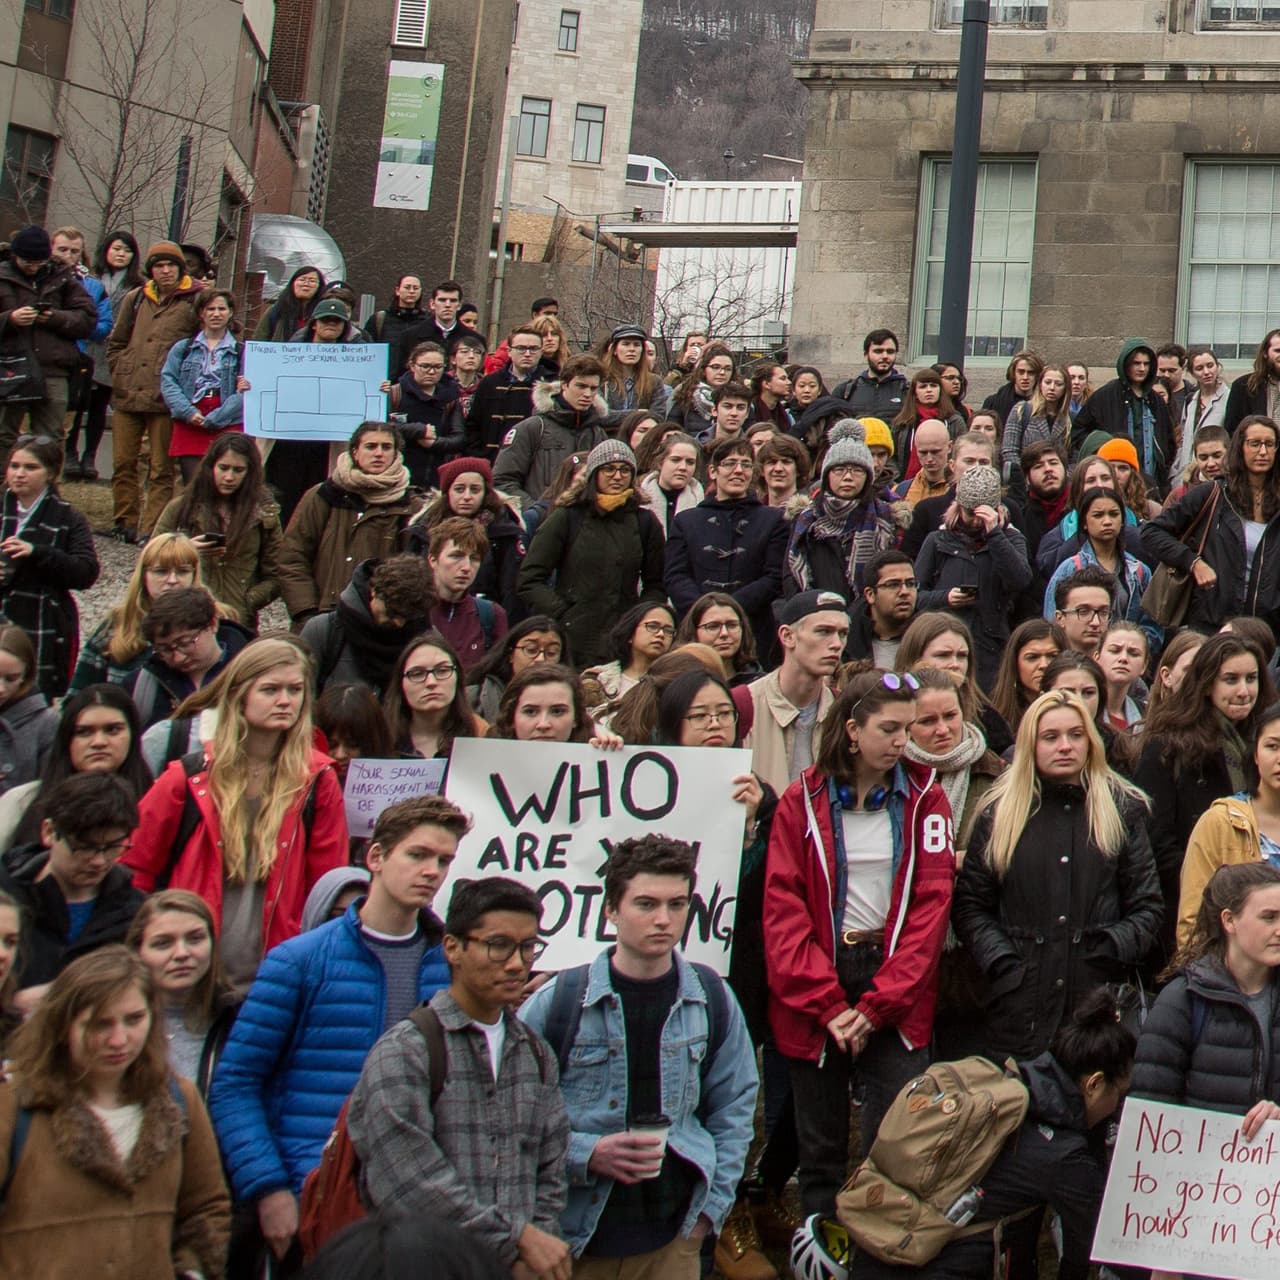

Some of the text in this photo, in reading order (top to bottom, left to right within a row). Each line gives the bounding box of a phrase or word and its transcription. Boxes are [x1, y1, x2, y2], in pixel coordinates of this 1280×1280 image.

[351, 782, 422, 796] HARASSMENT
[352, 763, 428, 780] YOUR SEXUAL
[489, 751, 679, 827] WHO
[358, 800, 374, 812] BE
[477, 832, 572, 872] ARE
[1136, 1111, 1183, 1154] No.
[1128, 1160, 1158, 1194] to
[1208, 1168, 1242, 1204] to
[1122, 1202, 1192, 1240] hours
[1212, 1221, 1236, 1245] in
